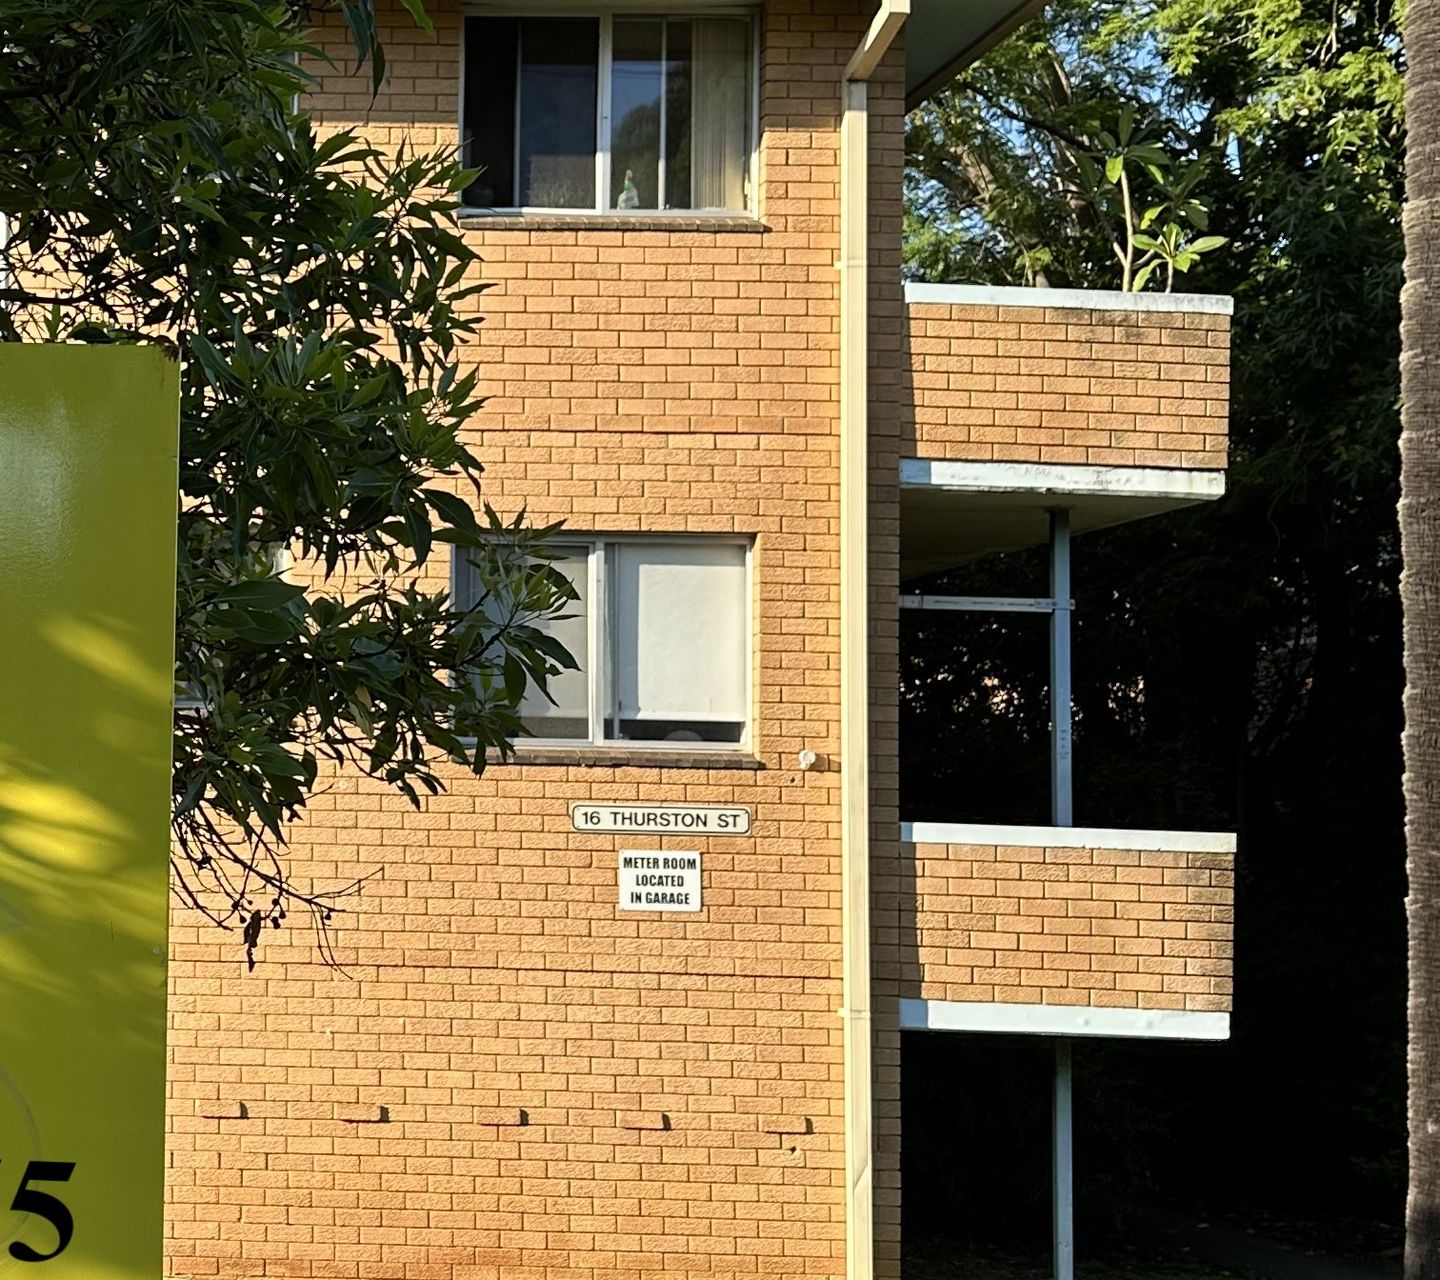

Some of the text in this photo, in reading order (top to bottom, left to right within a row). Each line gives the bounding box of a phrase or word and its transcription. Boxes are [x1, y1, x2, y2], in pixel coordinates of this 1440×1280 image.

[581, 811, 741, 828] 16 THURSTON ST
[623, 857, 697, 870] METER ROOM
[635, 874, 685, 888] LOCATED
[630, 891, 691, 905] IN GARAGE
